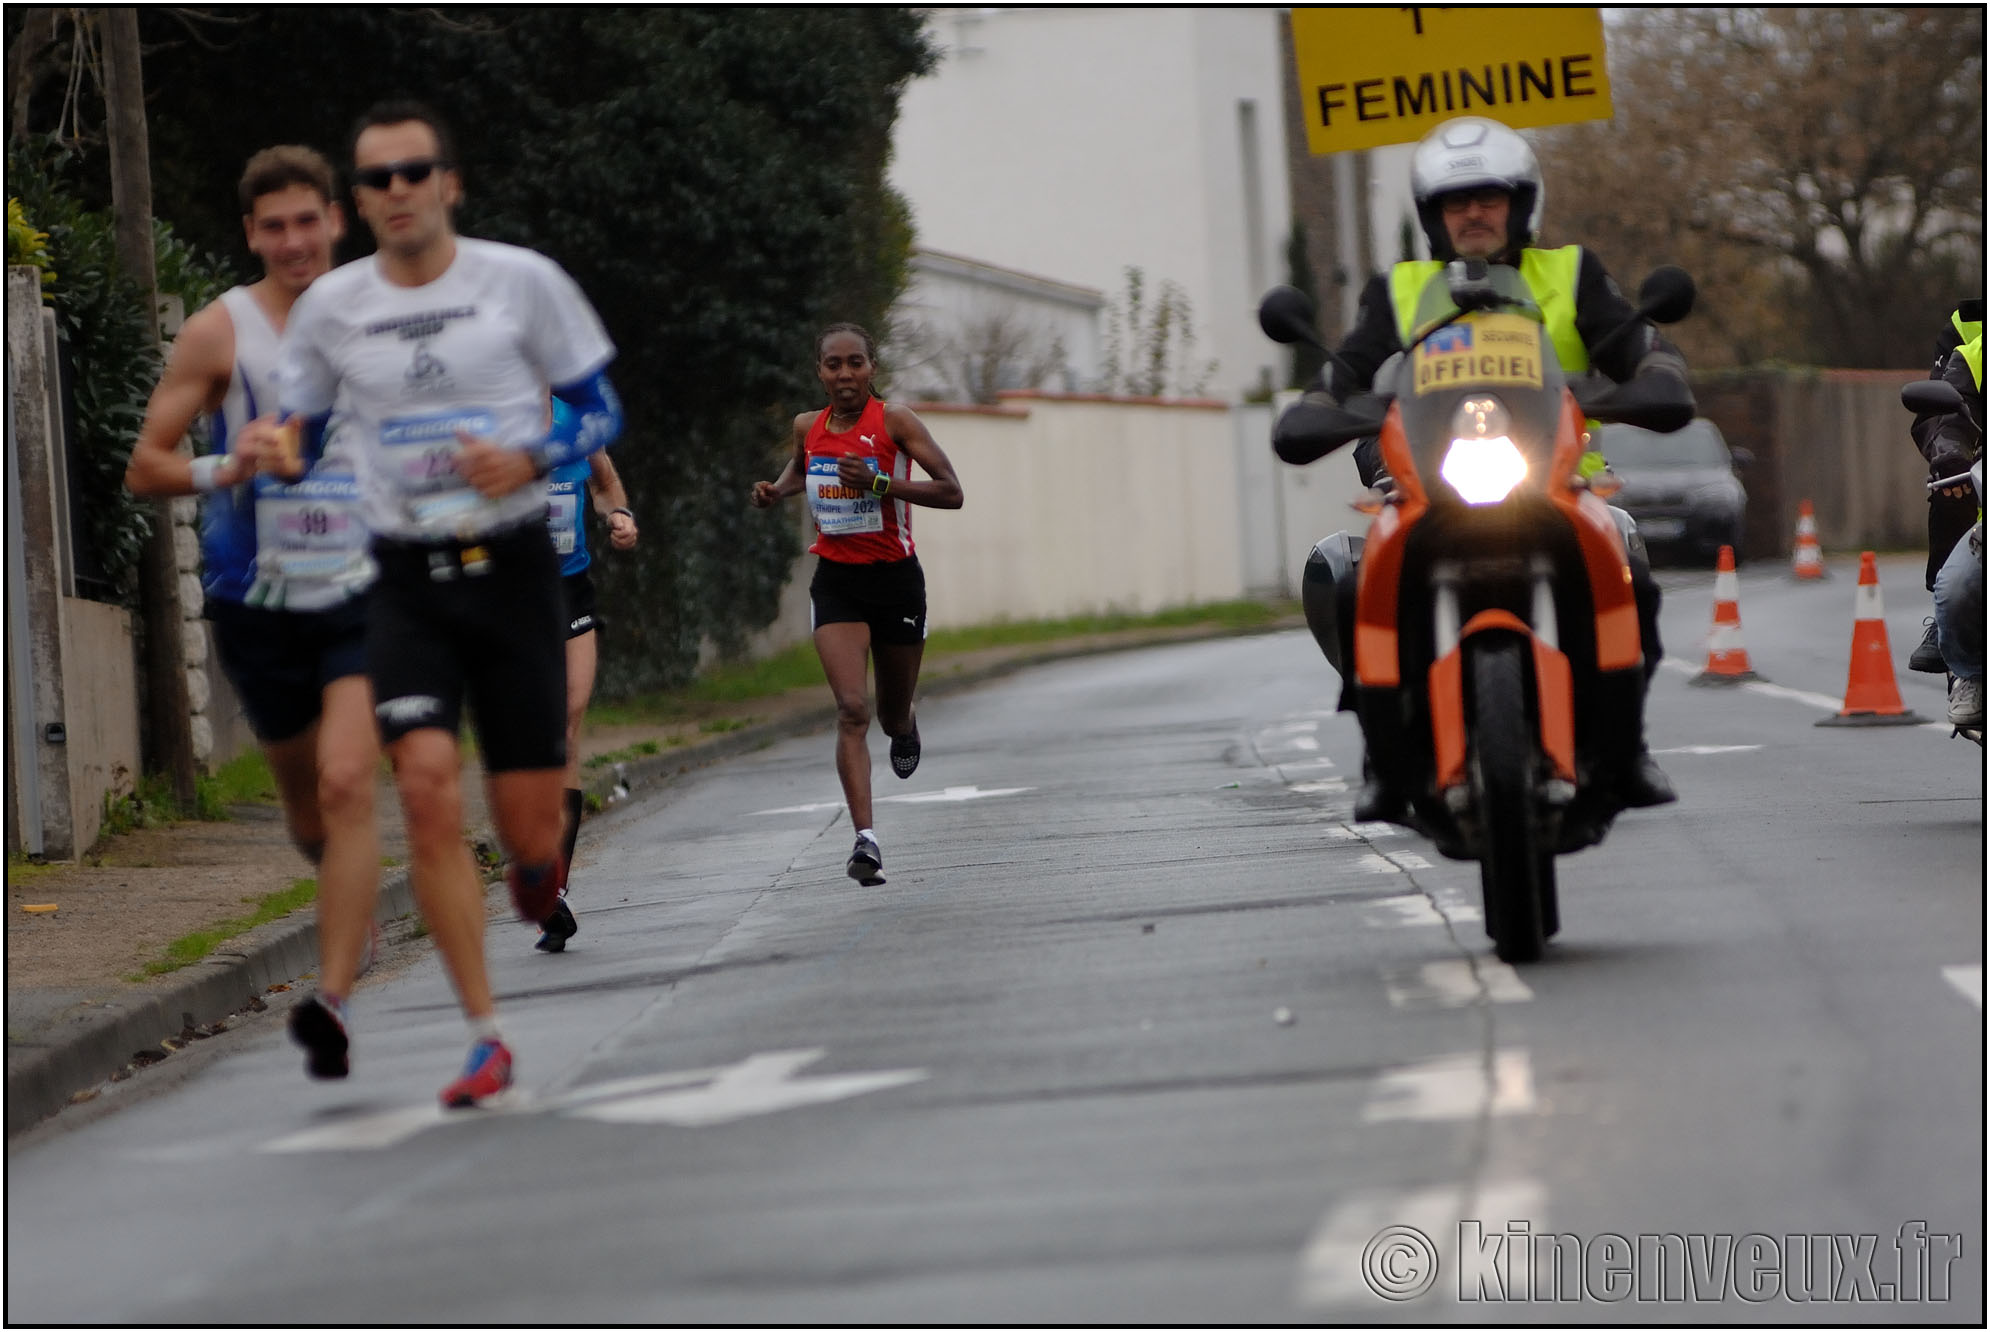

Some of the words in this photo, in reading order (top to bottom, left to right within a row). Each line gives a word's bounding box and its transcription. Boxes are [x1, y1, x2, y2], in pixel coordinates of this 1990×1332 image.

[1316, 54, 1596, 126] FEMININE
[1420, 355, 1539, 385] OFFICIEL
[853, 501, 875, 514] 202
